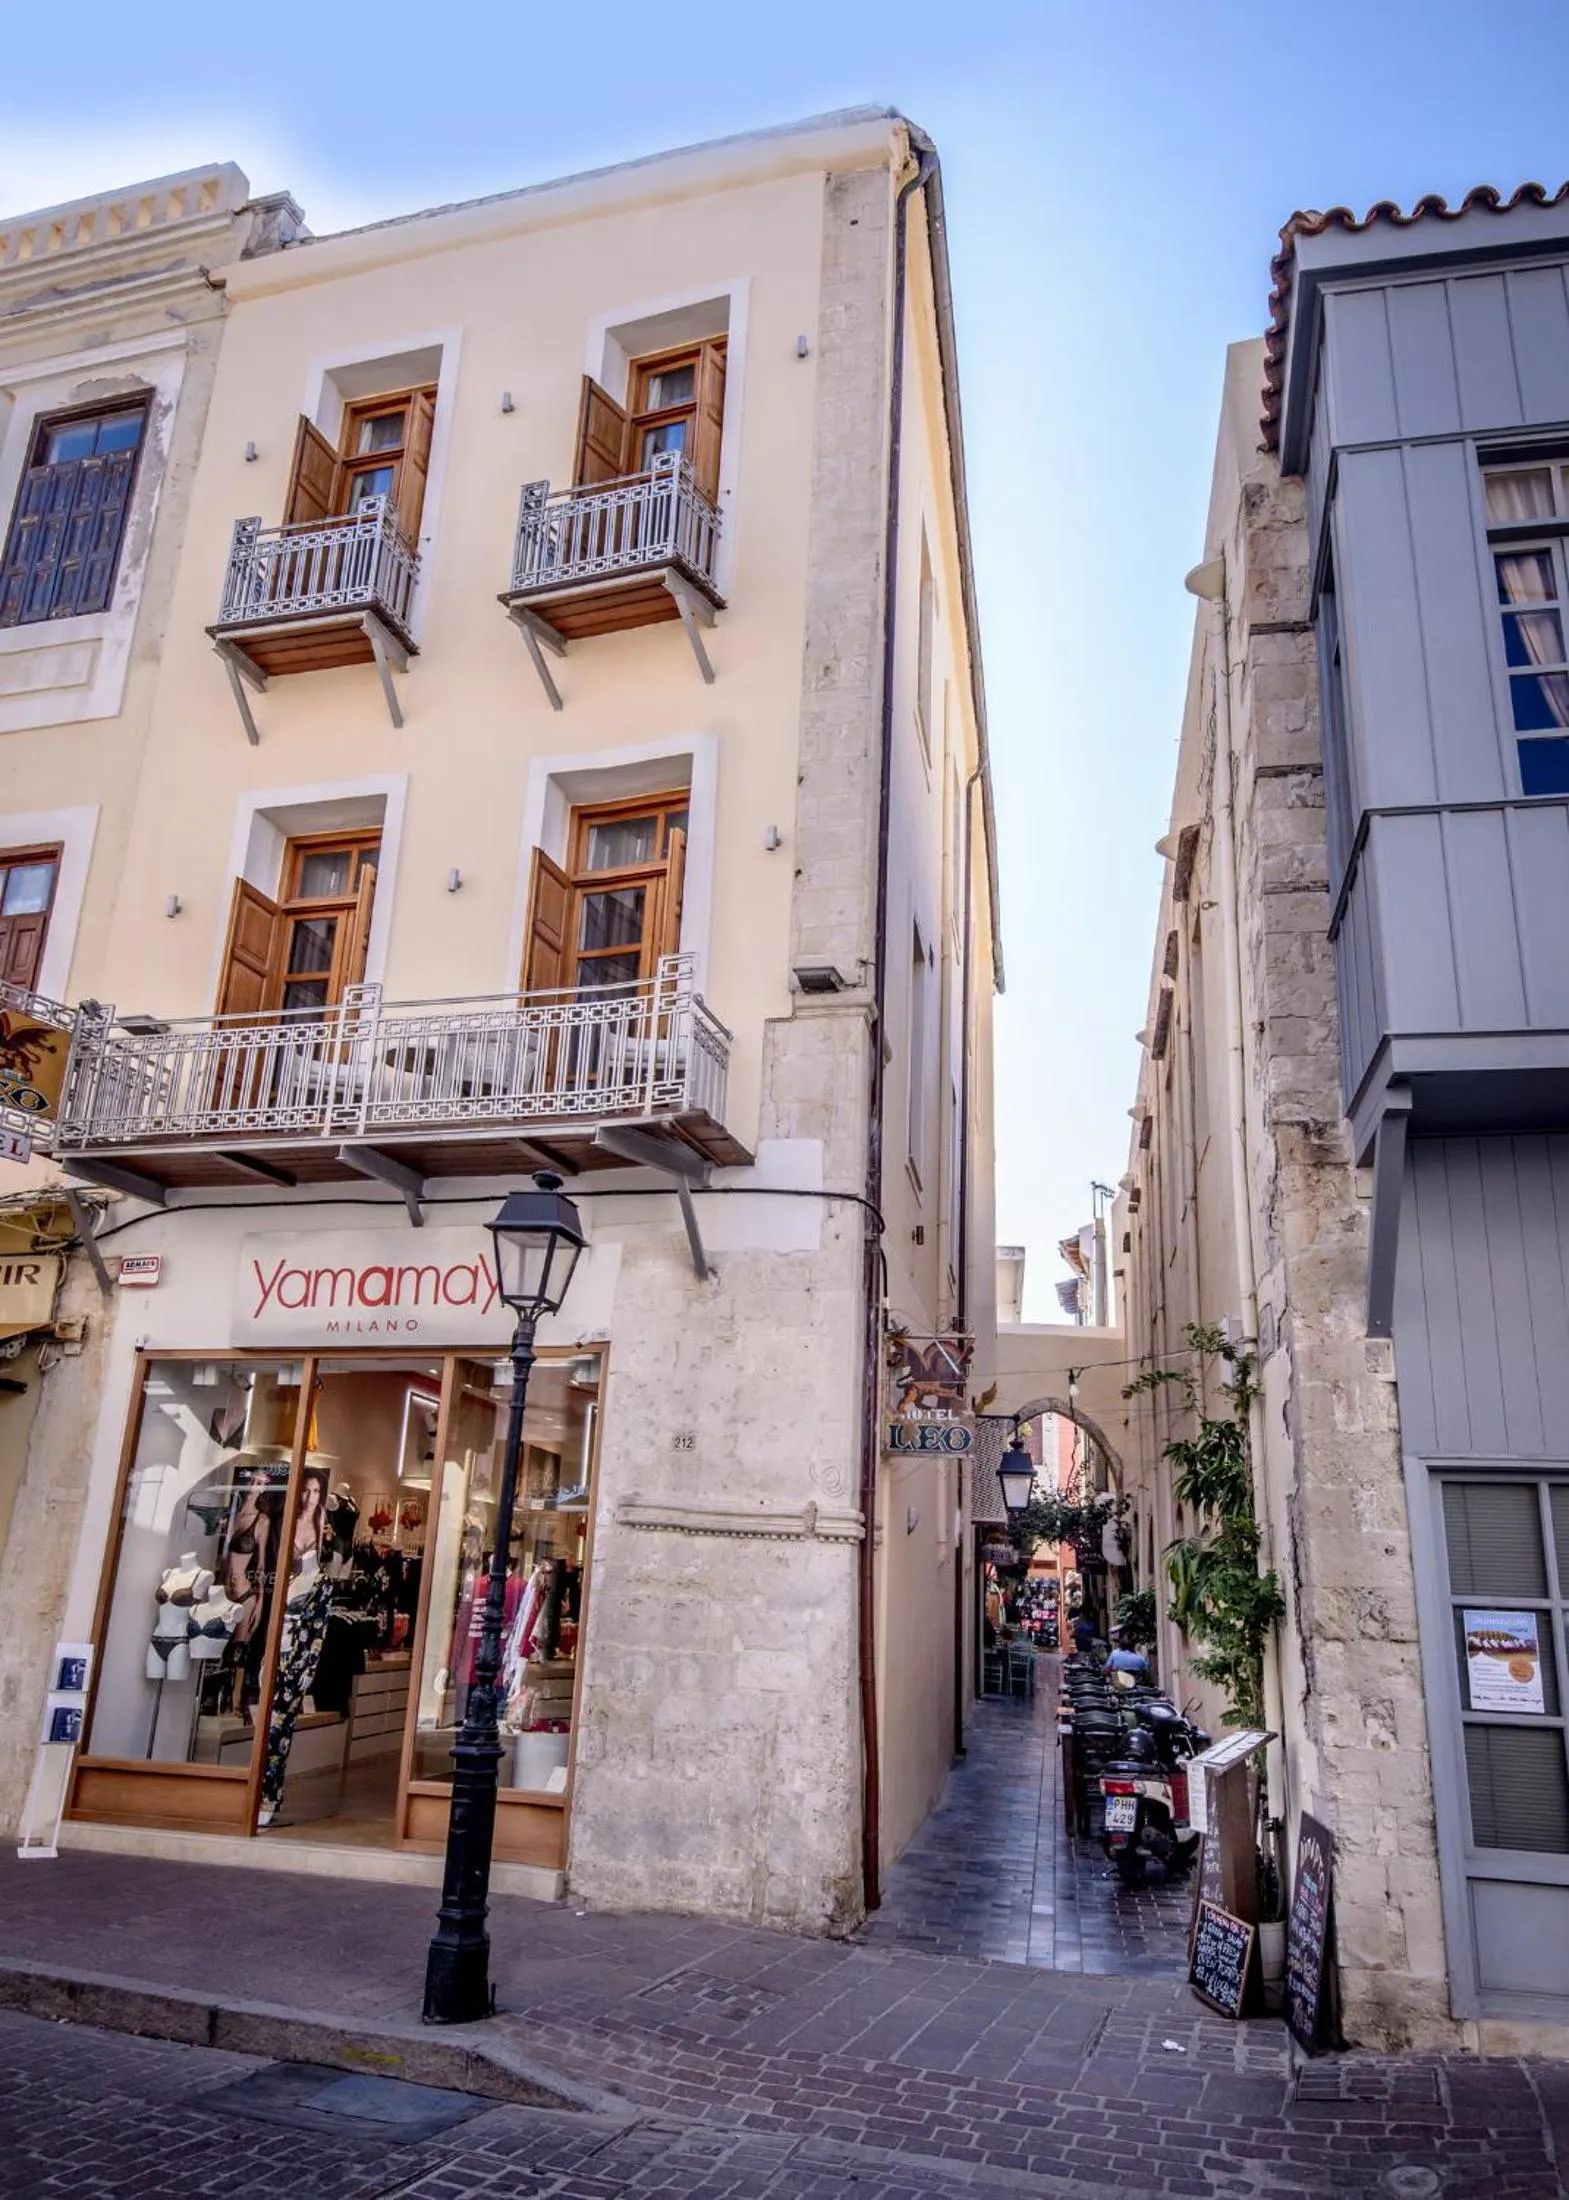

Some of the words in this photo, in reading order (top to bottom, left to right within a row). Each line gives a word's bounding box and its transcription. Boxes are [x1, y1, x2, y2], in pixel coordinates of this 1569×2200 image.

[0, 1080, 50, 1112] O
[254, 1253, 499, 1319] yamamay
[326, 1319, 419, 1332] MILANO
[674, 1435, 694, 1449] 212
[887, 1423, 973, 1453] LEO
[1112, 1812, 1134, 1825] 429
